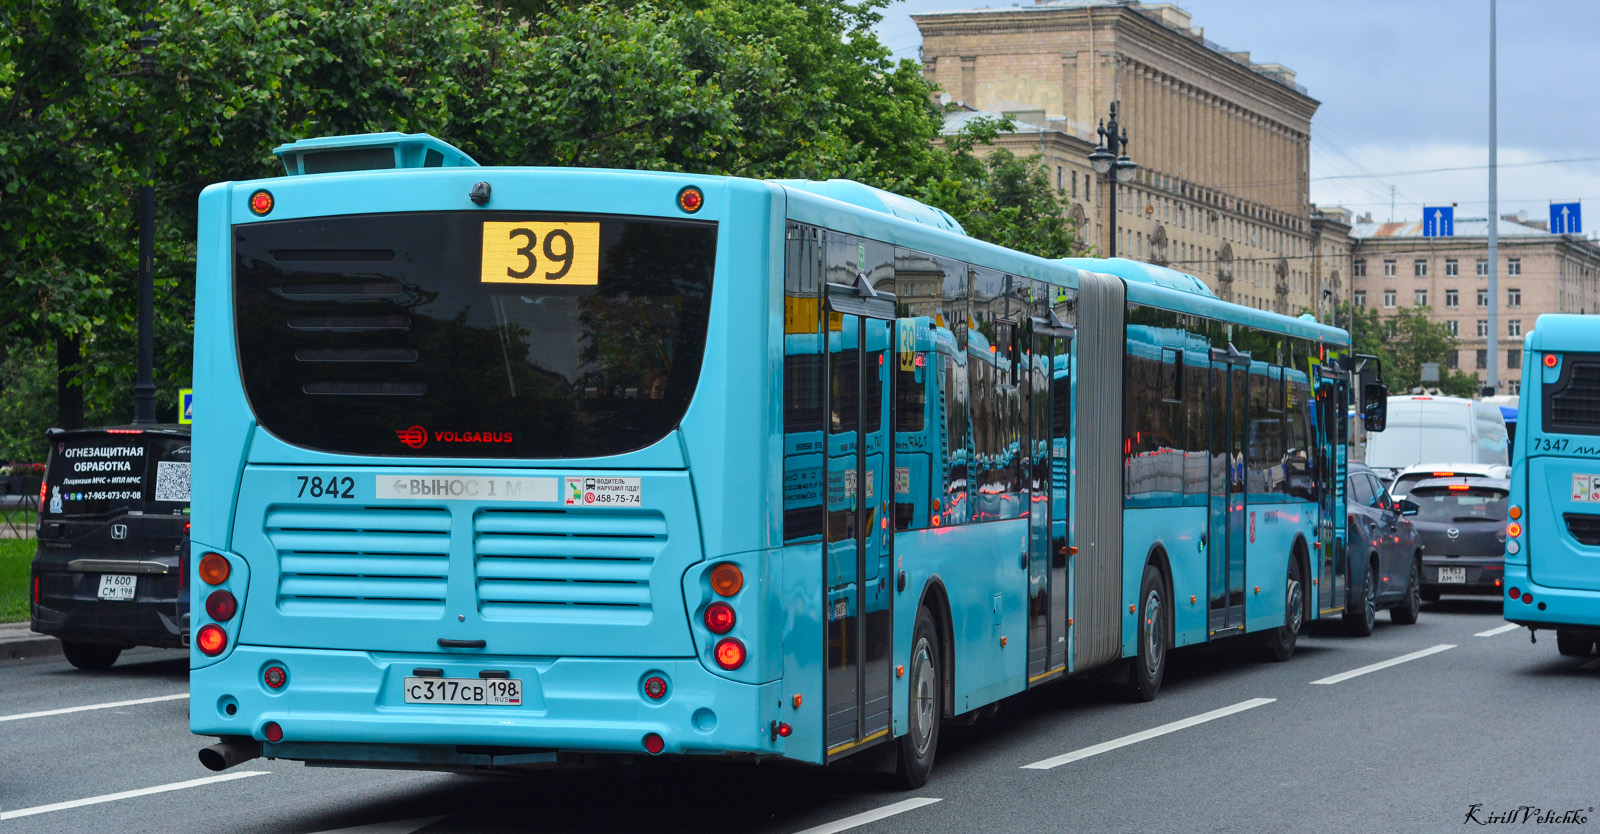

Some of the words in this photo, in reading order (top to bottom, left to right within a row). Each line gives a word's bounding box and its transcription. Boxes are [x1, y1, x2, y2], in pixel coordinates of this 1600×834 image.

[506, 227, 574, 281] 39
[434, 431, 513, 443] VOLGABUS
[1534, 438, 1569, 451] 7347
[65, 446, 144, 458] ОГНЕЗАЩИТНАЯ
[73, 461, 131, 472] ОБРАБОТКА
[297, 476, 355, 499] 7842
[410, 479, 480, 496] ВЫНОС
[487, 480, 497, 496] 1
[84, 491, 141, 500] +7-965-073-07-08
[596, 494, 640, 503] 458-75-74
[115, 576, 131, 585] 600
[102, 588, 116, 596] СМ
[411, 681, 484, 701] С317СВ
[488, 681, 516, 696] 198
